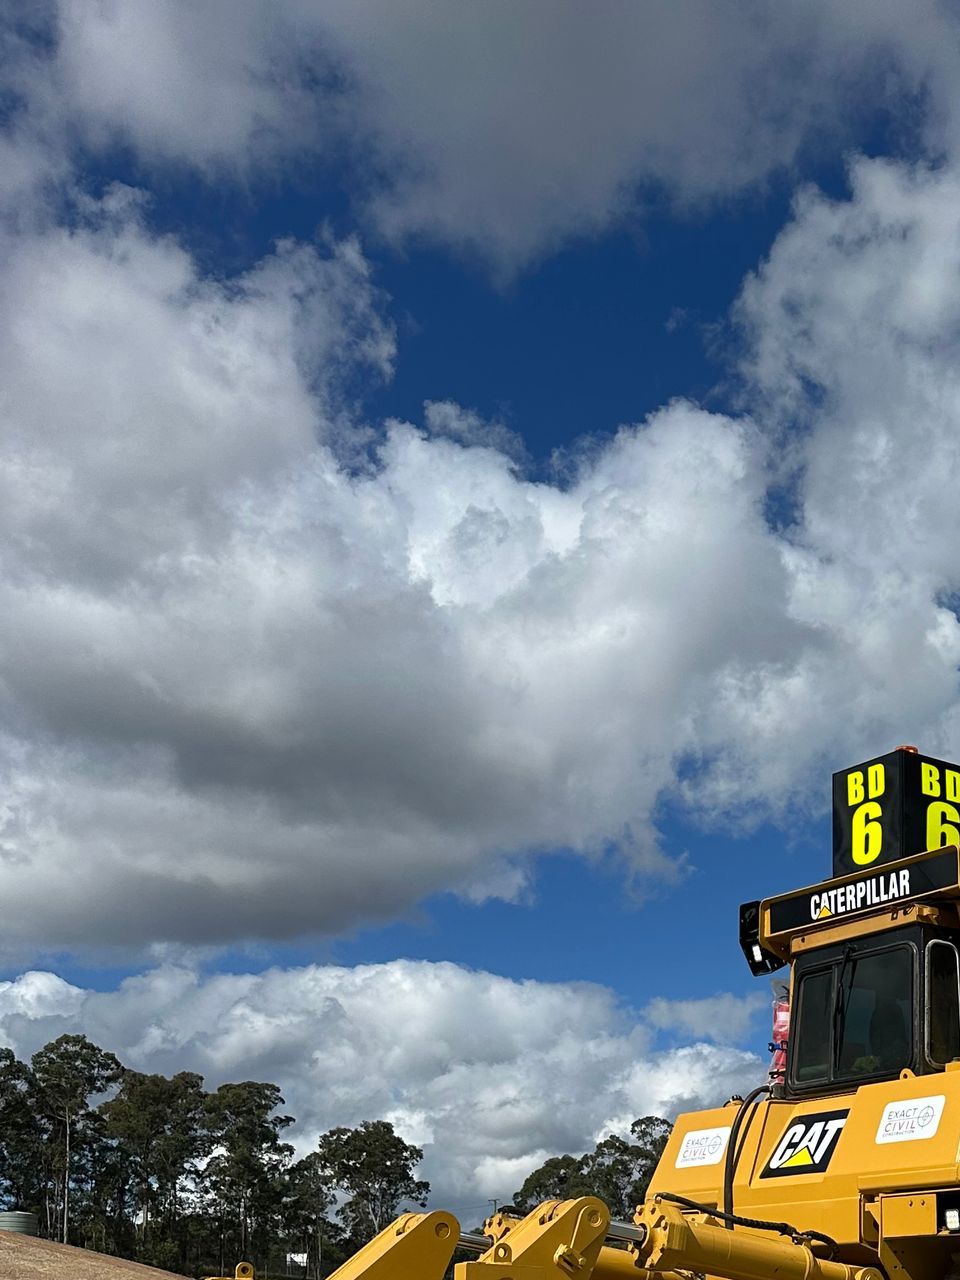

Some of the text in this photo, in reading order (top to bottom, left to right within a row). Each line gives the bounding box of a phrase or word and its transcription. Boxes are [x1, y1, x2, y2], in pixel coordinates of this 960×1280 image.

[847, 763, 885, 807] BD
[851, 801, 882, 865] 6
[926, 801, 960, 852] 6
[810, 869, 910, 921] CATERPILLAR
[884, 1120, 916, 1133] CIVIL
[887, 1107, 919, 1120] EXACT
[682, 1148, 707, 1158] CIVIL
[685, 1137, 710, 1148] EXACT
[769, 1118, 848, 1170] CAT
